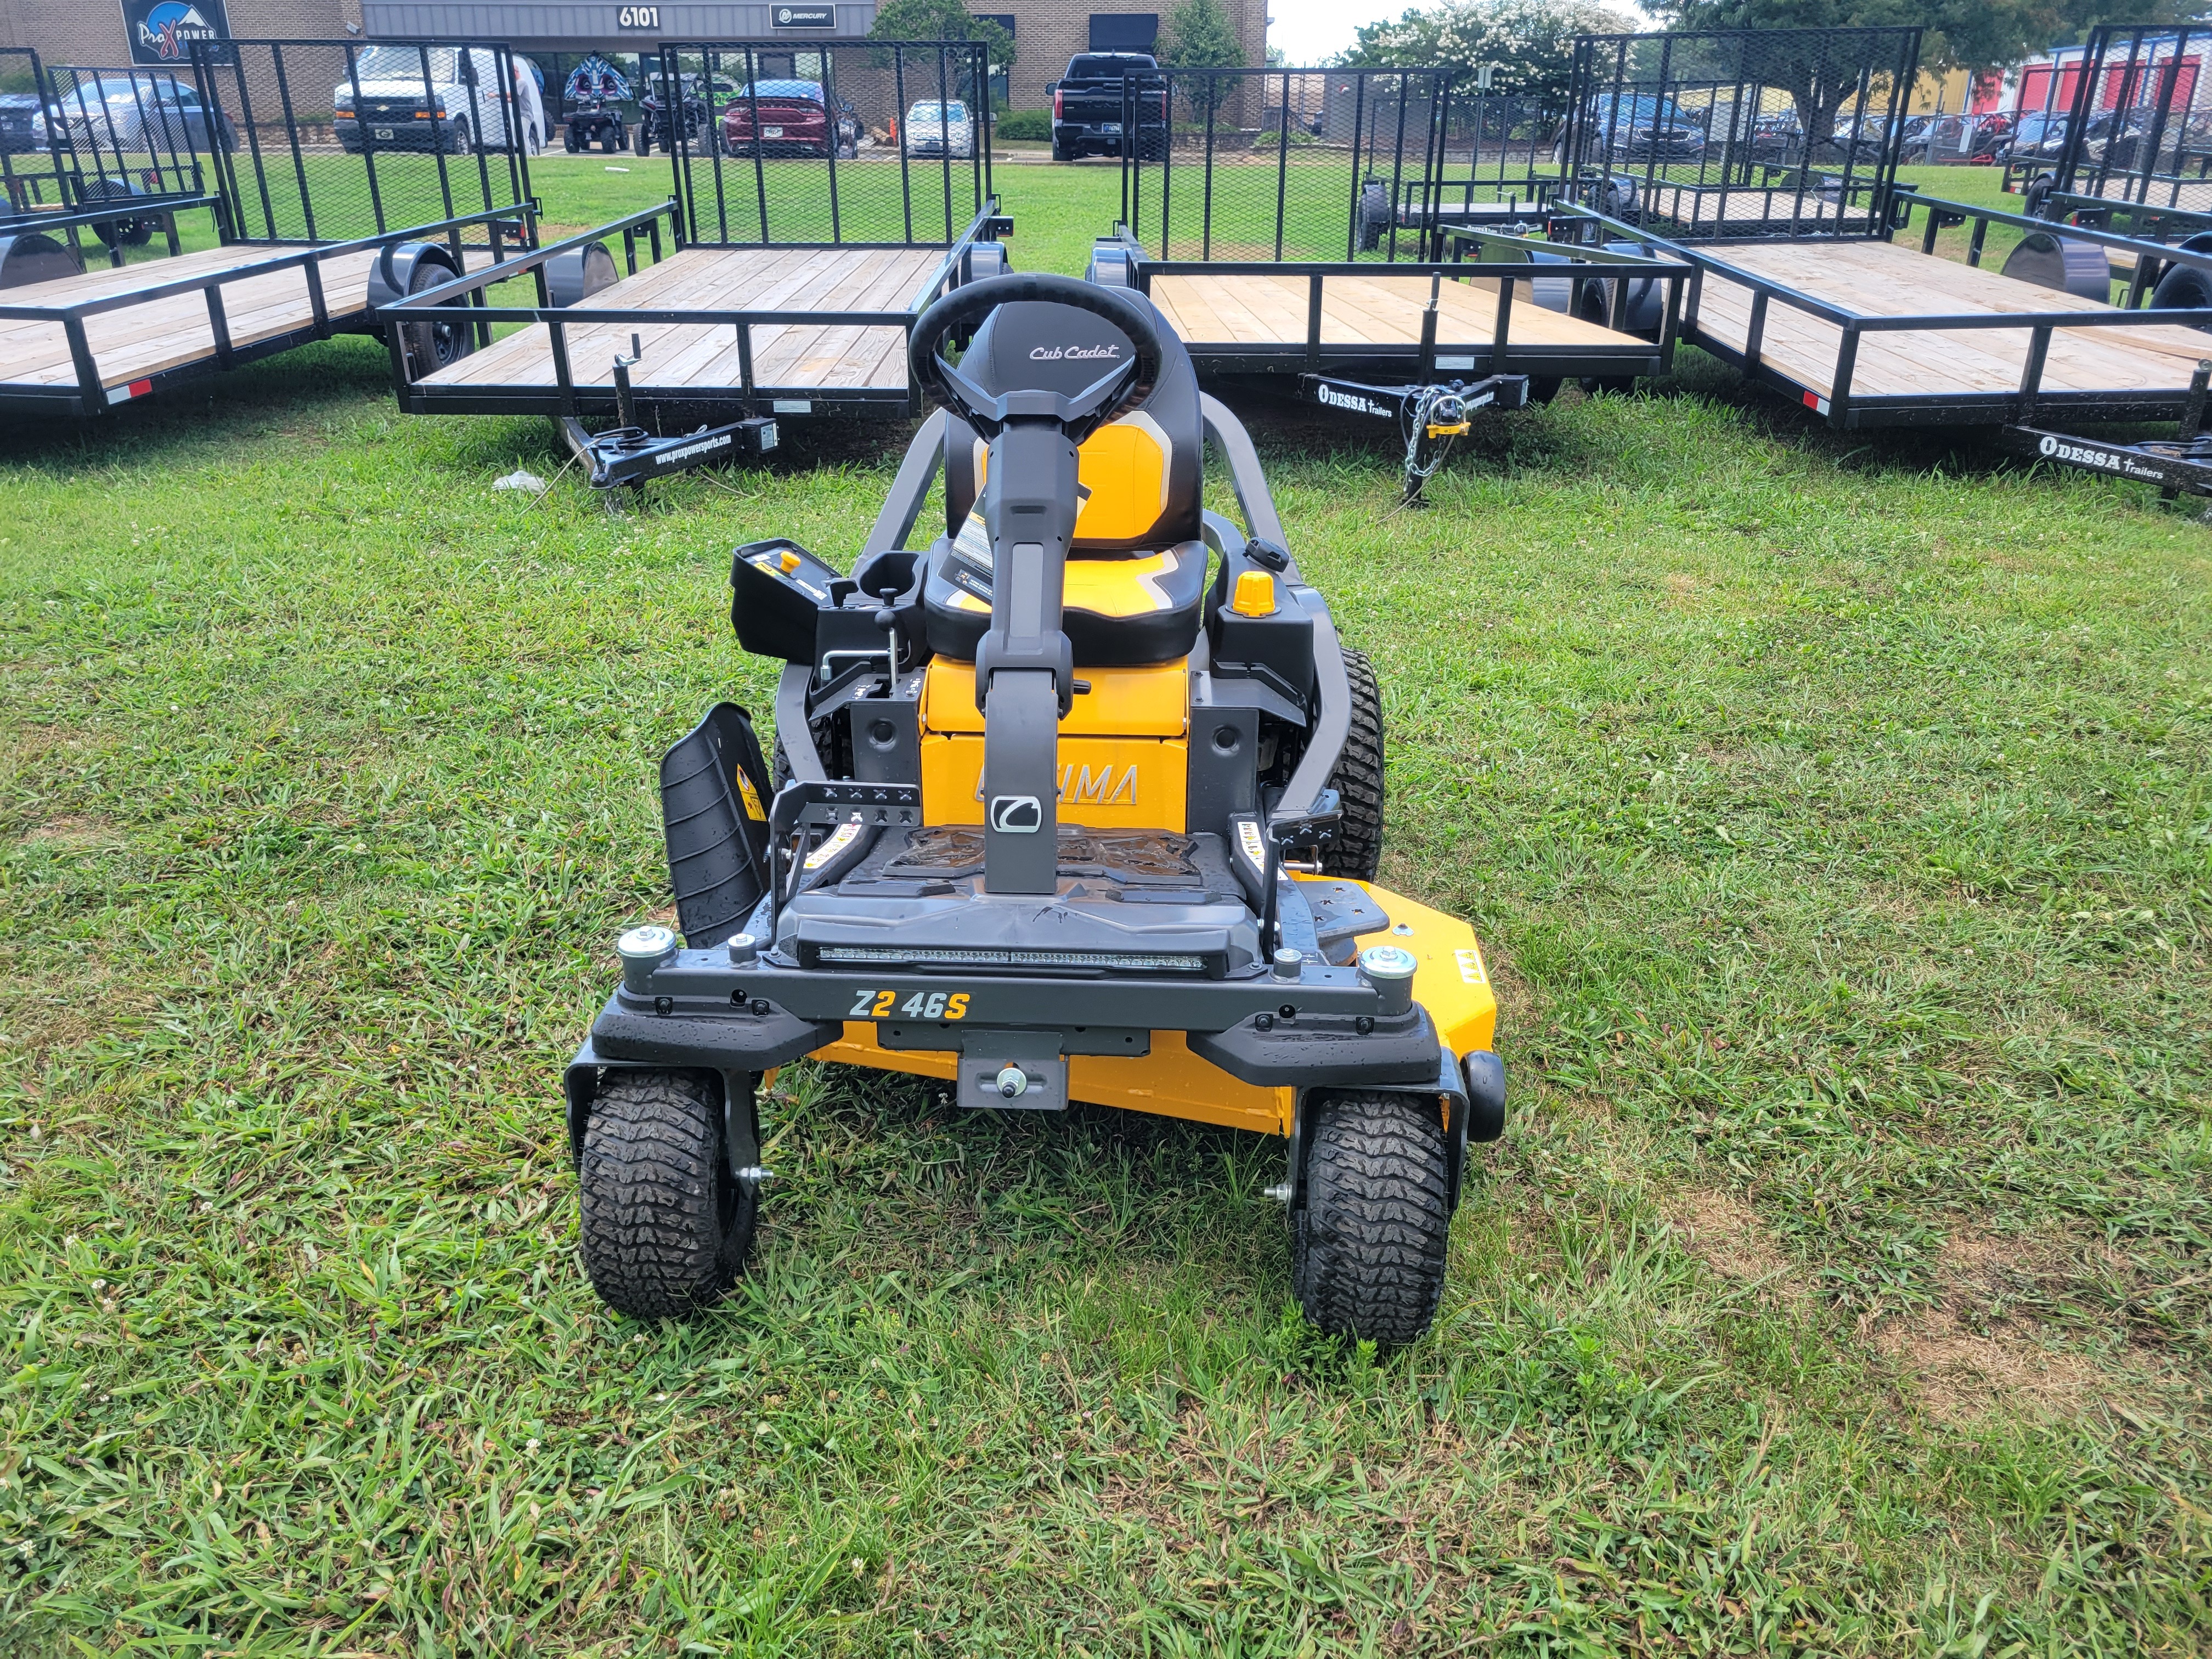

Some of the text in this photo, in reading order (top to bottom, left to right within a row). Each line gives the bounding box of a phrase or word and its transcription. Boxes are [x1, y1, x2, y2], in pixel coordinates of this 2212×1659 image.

[619, 7, 658, 27] 6101
[176, 30, 215, 40] POWER
[1029, 344, 1120, 360] Cub Cadet
[1318, 383, 1367, 412] ODESSA
[655, 434, 731, 465] www.proxpowersports.com
[2040, 436, 2120, 470] ODESSA
[849, 990, 970, 1019] Z2 46S
